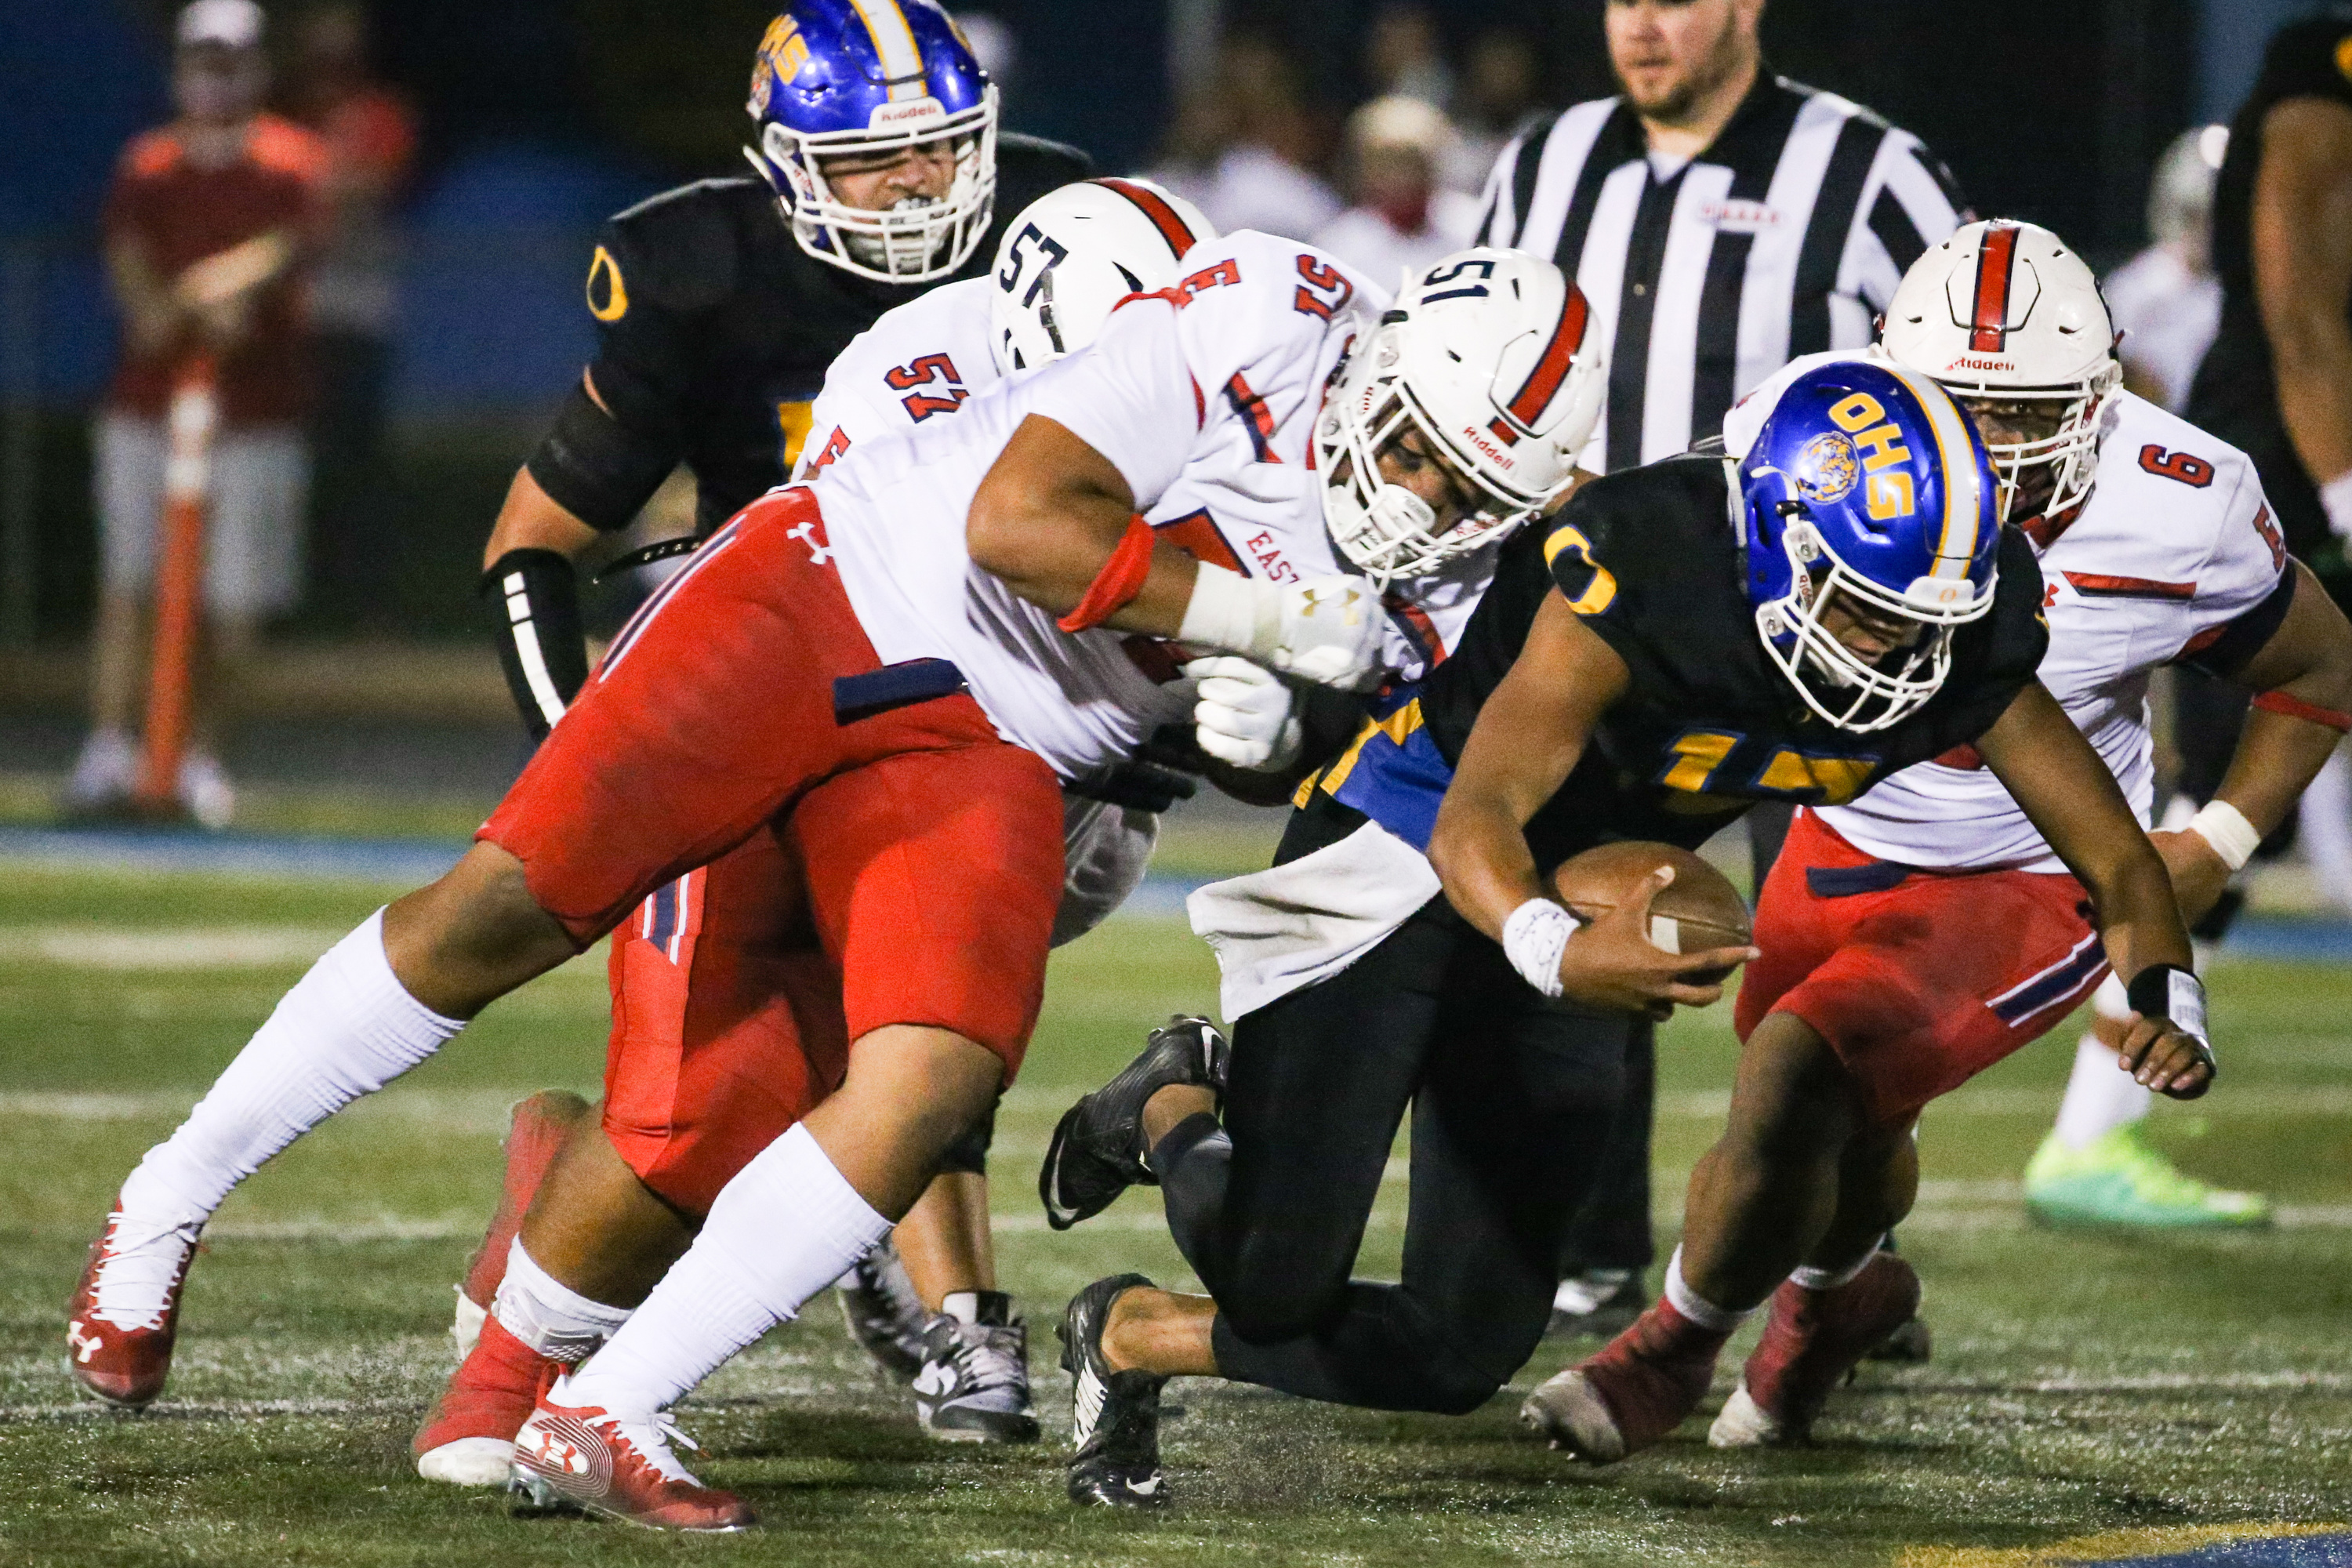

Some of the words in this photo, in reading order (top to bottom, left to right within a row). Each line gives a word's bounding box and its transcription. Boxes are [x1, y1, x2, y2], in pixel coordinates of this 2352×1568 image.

[1000, 222, 1069, 309] 57
[1420, 260, 1497, 306] 51
[884, 352, 970, 424] 57
[1462, 426, 1515, 470] Riddell
[1828, 392, 1915, 521] OHS
[2138, 443, 2216, 488] 6
